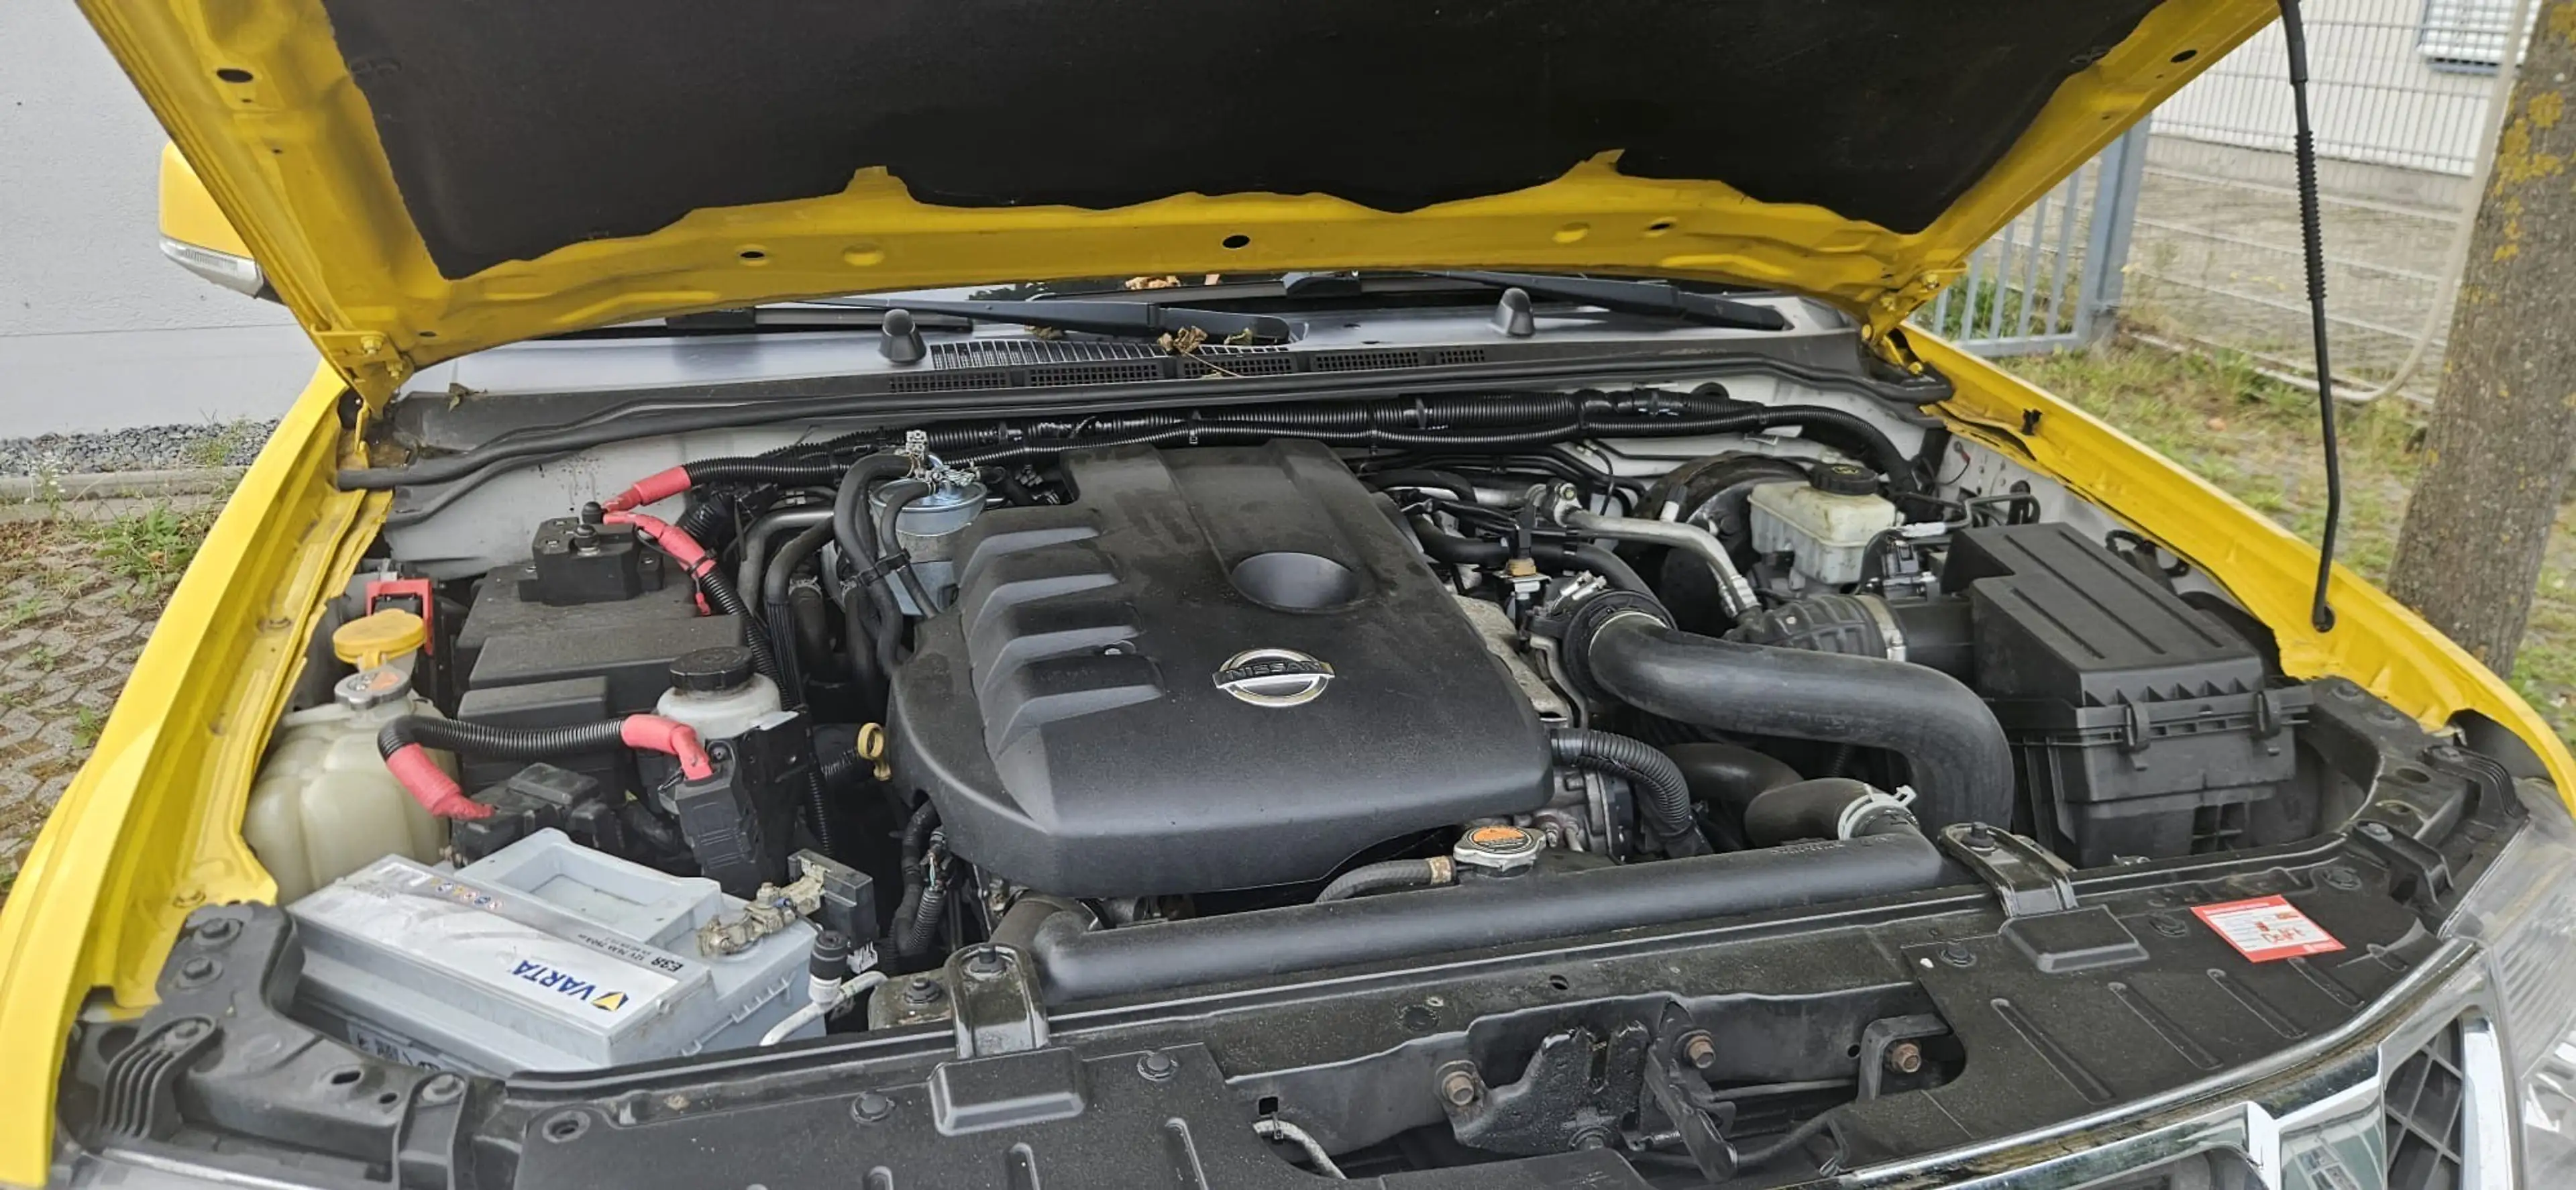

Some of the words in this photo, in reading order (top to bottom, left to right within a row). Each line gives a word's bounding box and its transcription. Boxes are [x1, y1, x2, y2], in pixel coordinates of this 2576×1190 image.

[1229, 660, 1321, 682] NISSAN
[650, 956, 684, 973] E38
[512, 959, 597, 1001] VARTA
